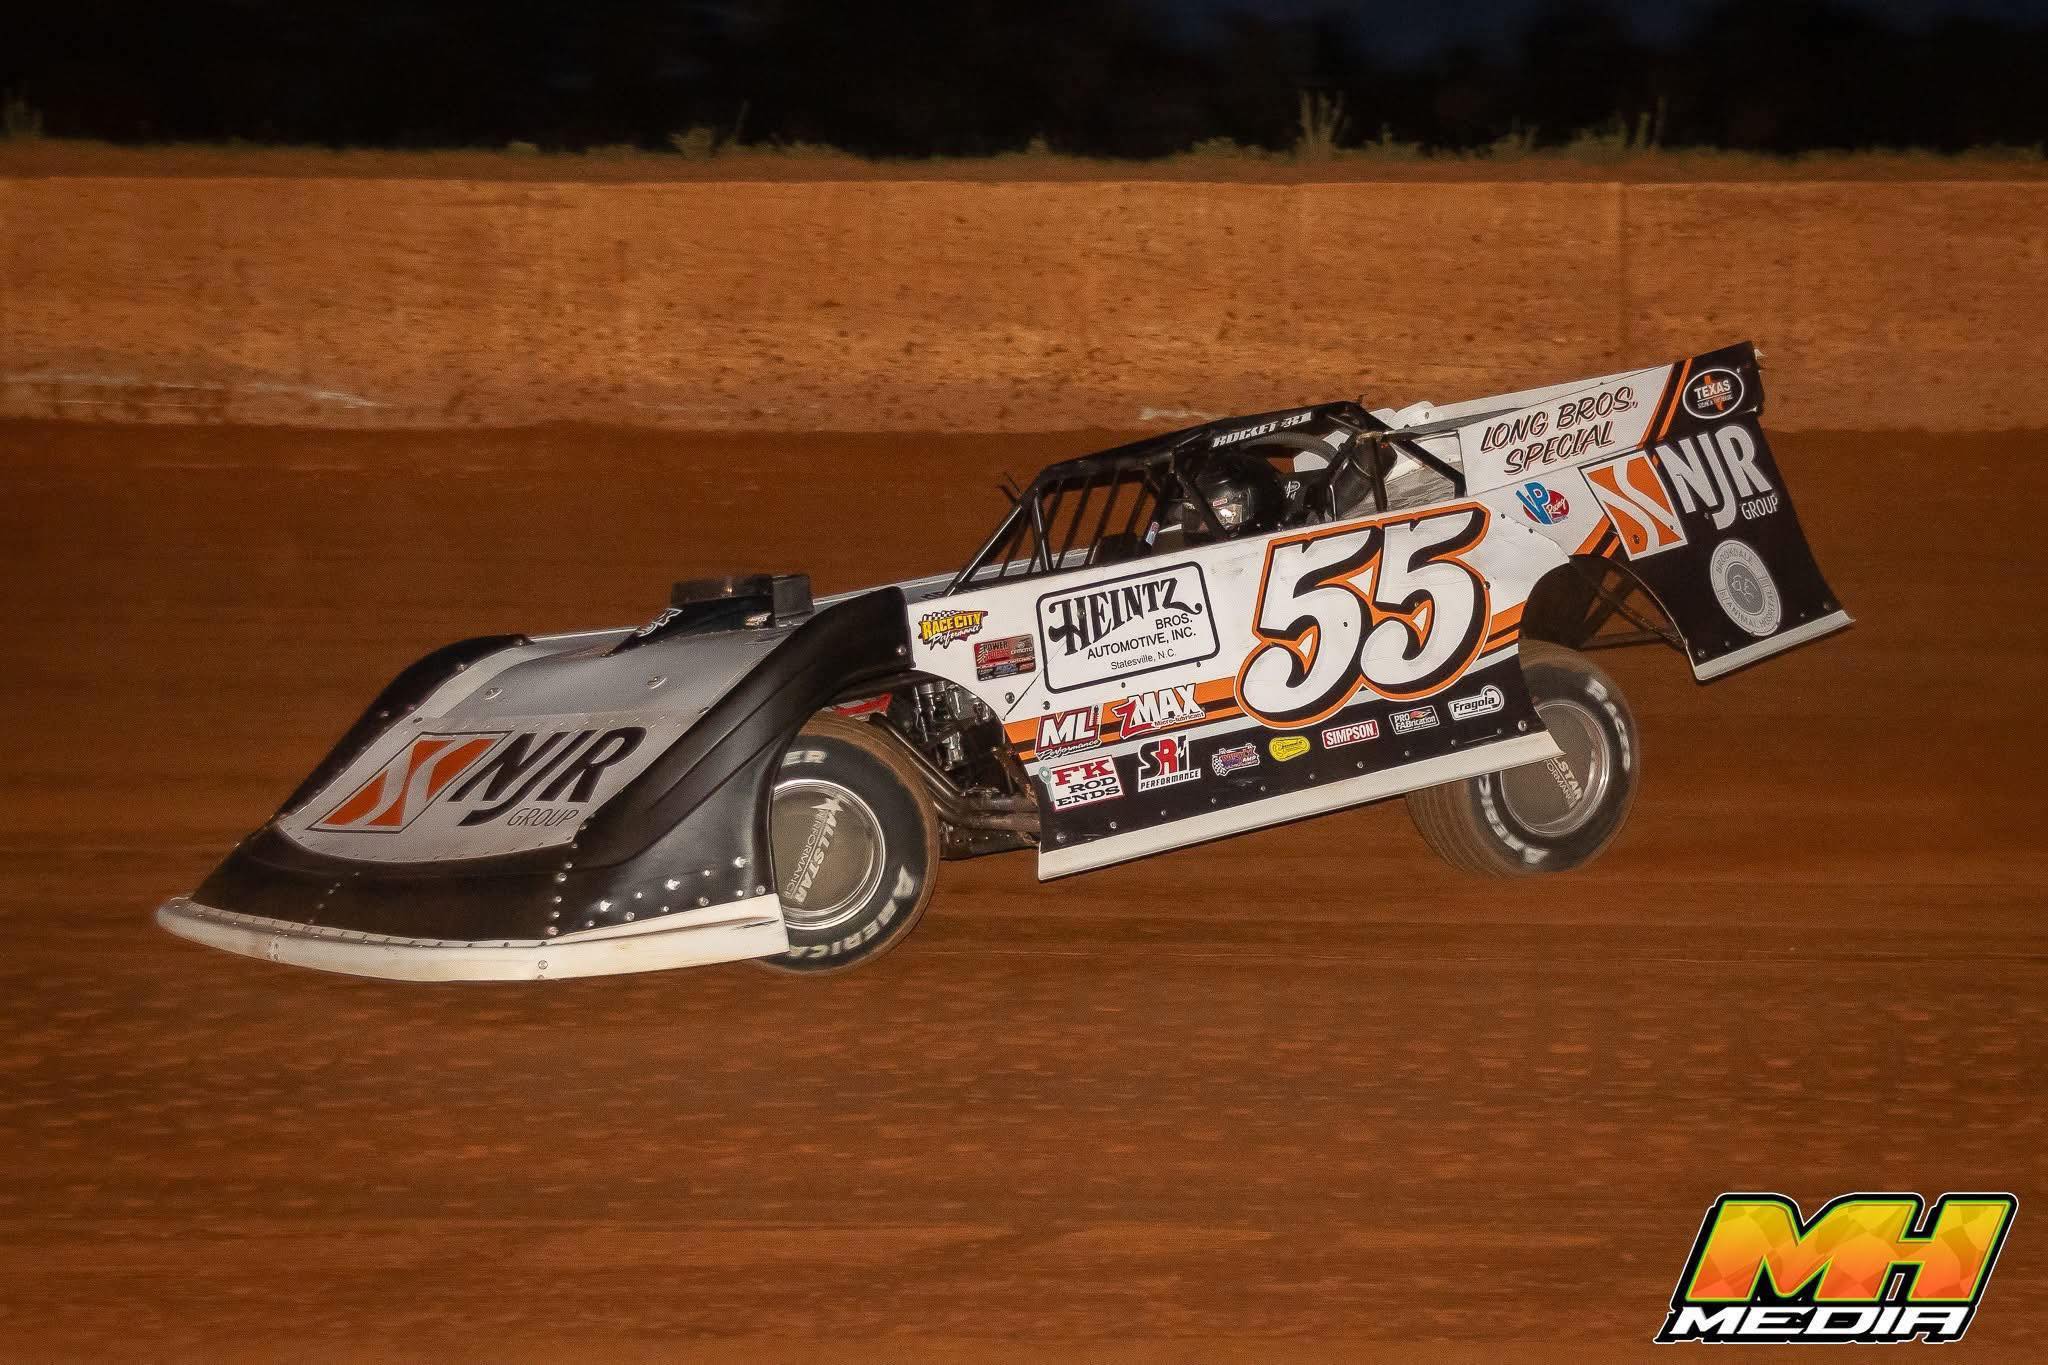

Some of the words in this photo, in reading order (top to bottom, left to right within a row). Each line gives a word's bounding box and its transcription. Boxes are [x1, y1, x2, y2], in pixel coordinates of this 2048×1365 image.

[1694, 379, 1731, 400] TEXAS
[1212, 421, 1279, 448] ROCKET
[1480, 411, 1549, 453] LONG
[1503, 421, 1615, 475] SPECIAL
[1654, 425, 1773, 530] NJR
[1515, 482, 1552, 525] VP
[1741, 494, 1778, 520] GROUP
[920, 617, 954, 641] RACE
[954, 611, 982, 629] CITY
[1048, 578, 1203, 656] HEINTZ
[1155, 612, 1193, 630] BROS.
[1240, 506, 1486, 722] 55
[1087, 631, 1170, 660] AUTOMOTIVE,
[1171, 626, 1197, 641] INC.
[1111, 653, 1156, 670] Statesville,
[1453, 696, 1495, 714] Fragola
[1394, 713, 1410, 724] PRO
[1395, 715, 1436, 732] FABrication
[1326, 723, 1376, 745] SIMPSON
[447, 726, 647, 826] NJR
[1053, 758, 1114, 787] FK
[1069, 776, 1117, 794] ROD
[1140, 769, 1200, 790] PERFORMANCE
[1055, 786, 1121, 807] ENDS
[507, 807, 579, 827] GROUP
